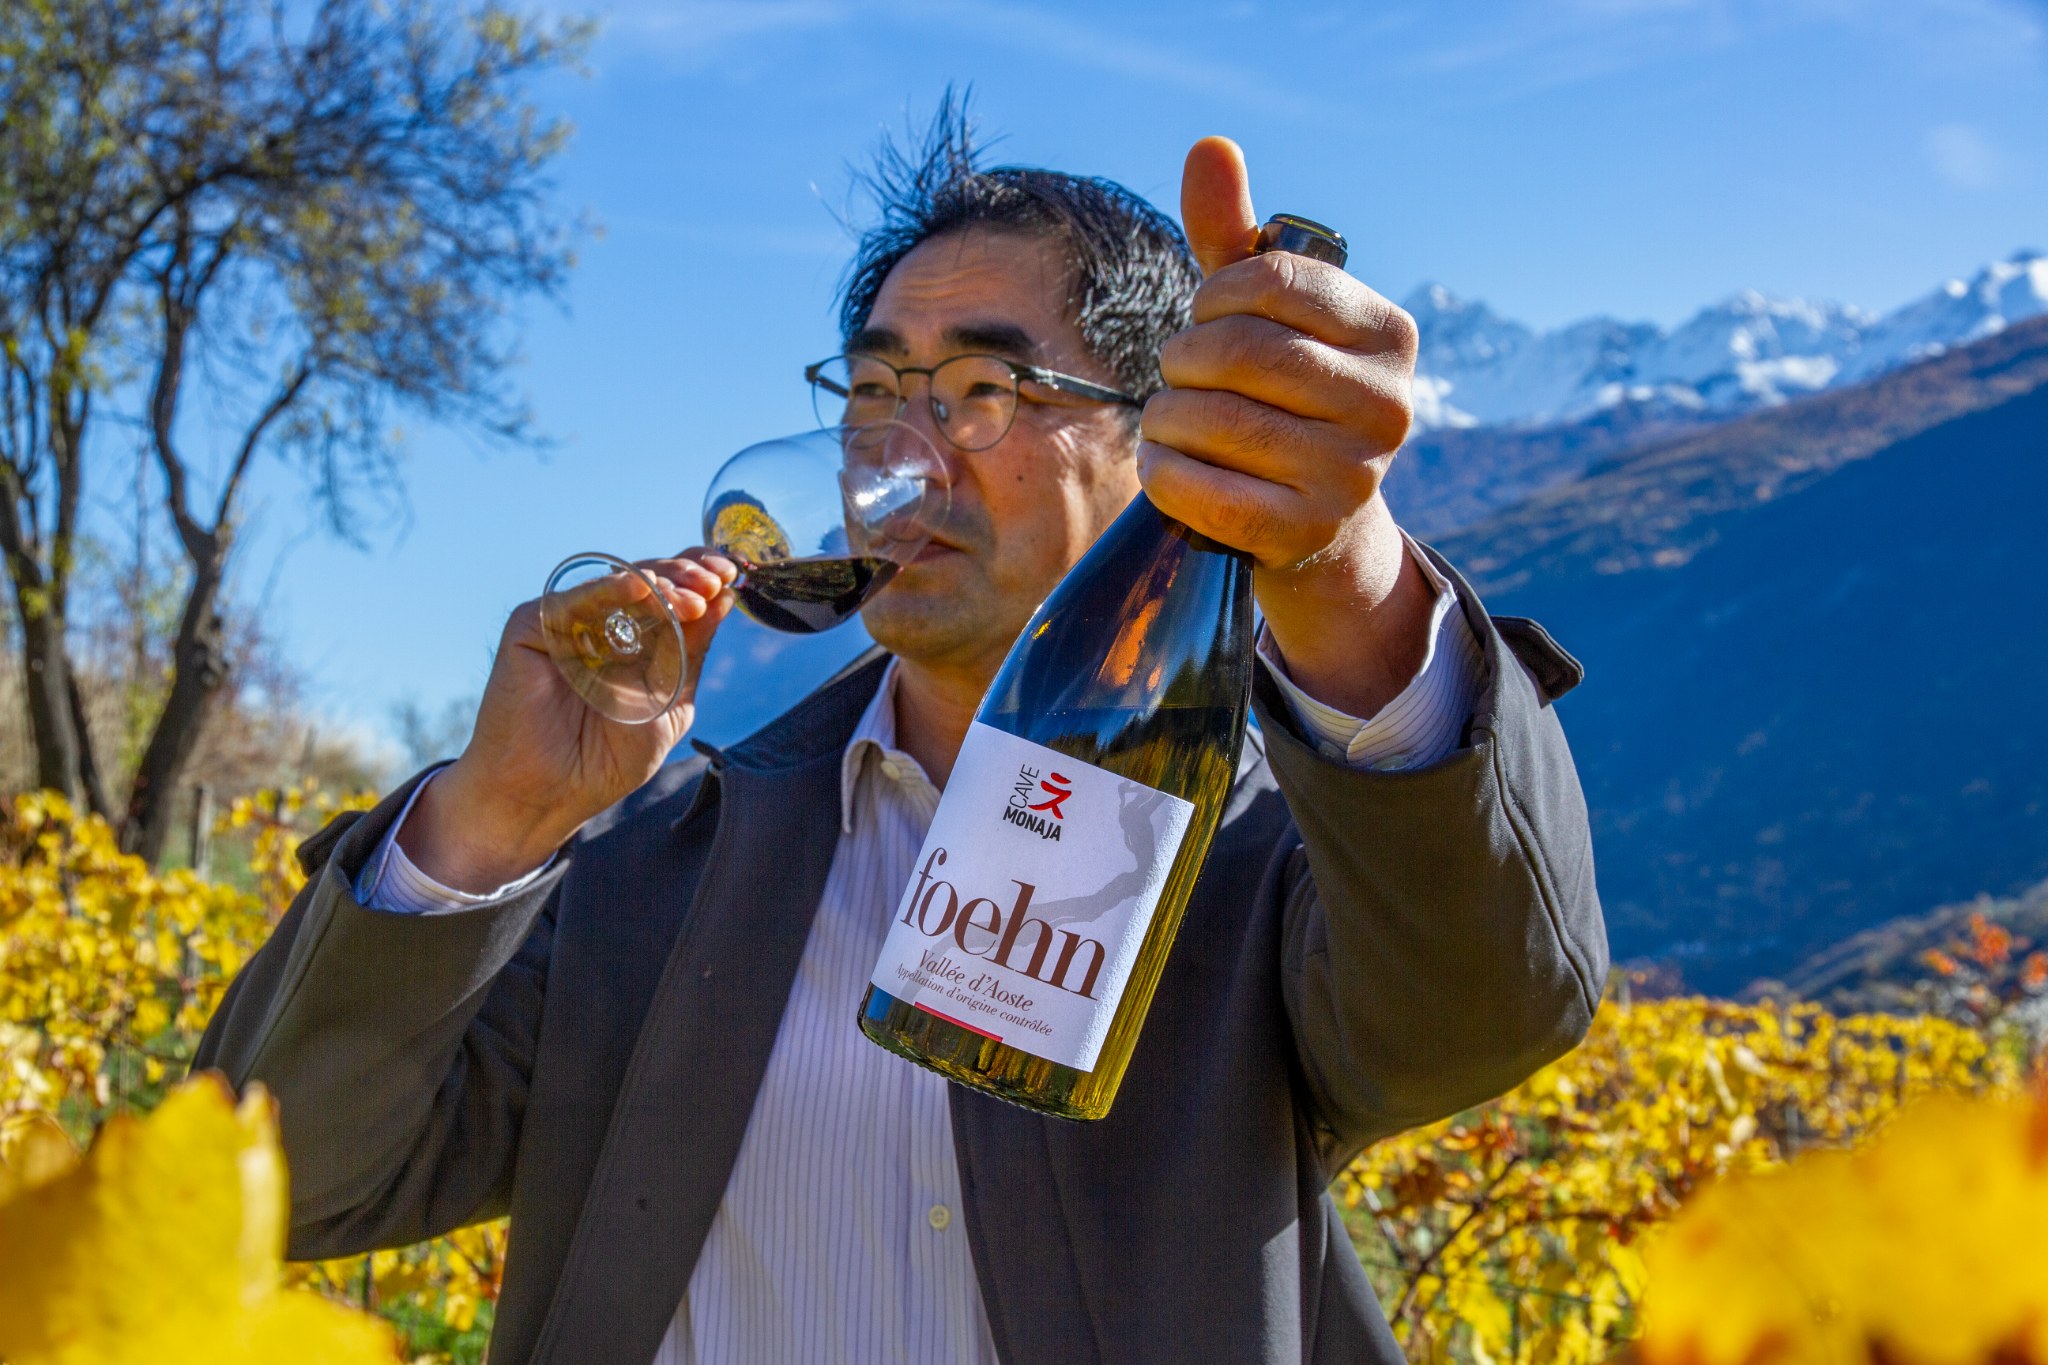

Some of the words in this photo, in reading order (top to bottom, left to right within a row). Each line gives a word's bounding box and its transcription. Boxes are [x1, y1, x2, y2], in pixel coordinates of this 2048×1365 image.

[1009, 764, 1040, 808] CAVE
[1003, 806, 1062, 841] MONAJA
[899, 847, 1106, 1001] foehn
[895, 962, 944, 994] Appellation
[947, 986, 997, 1016] d'origine
[1000, 1011, 1053, 1036] contrôlée
[919, 949, 965, 985] Vallée
[969, 973, 1033, 1012] d'Aoste
